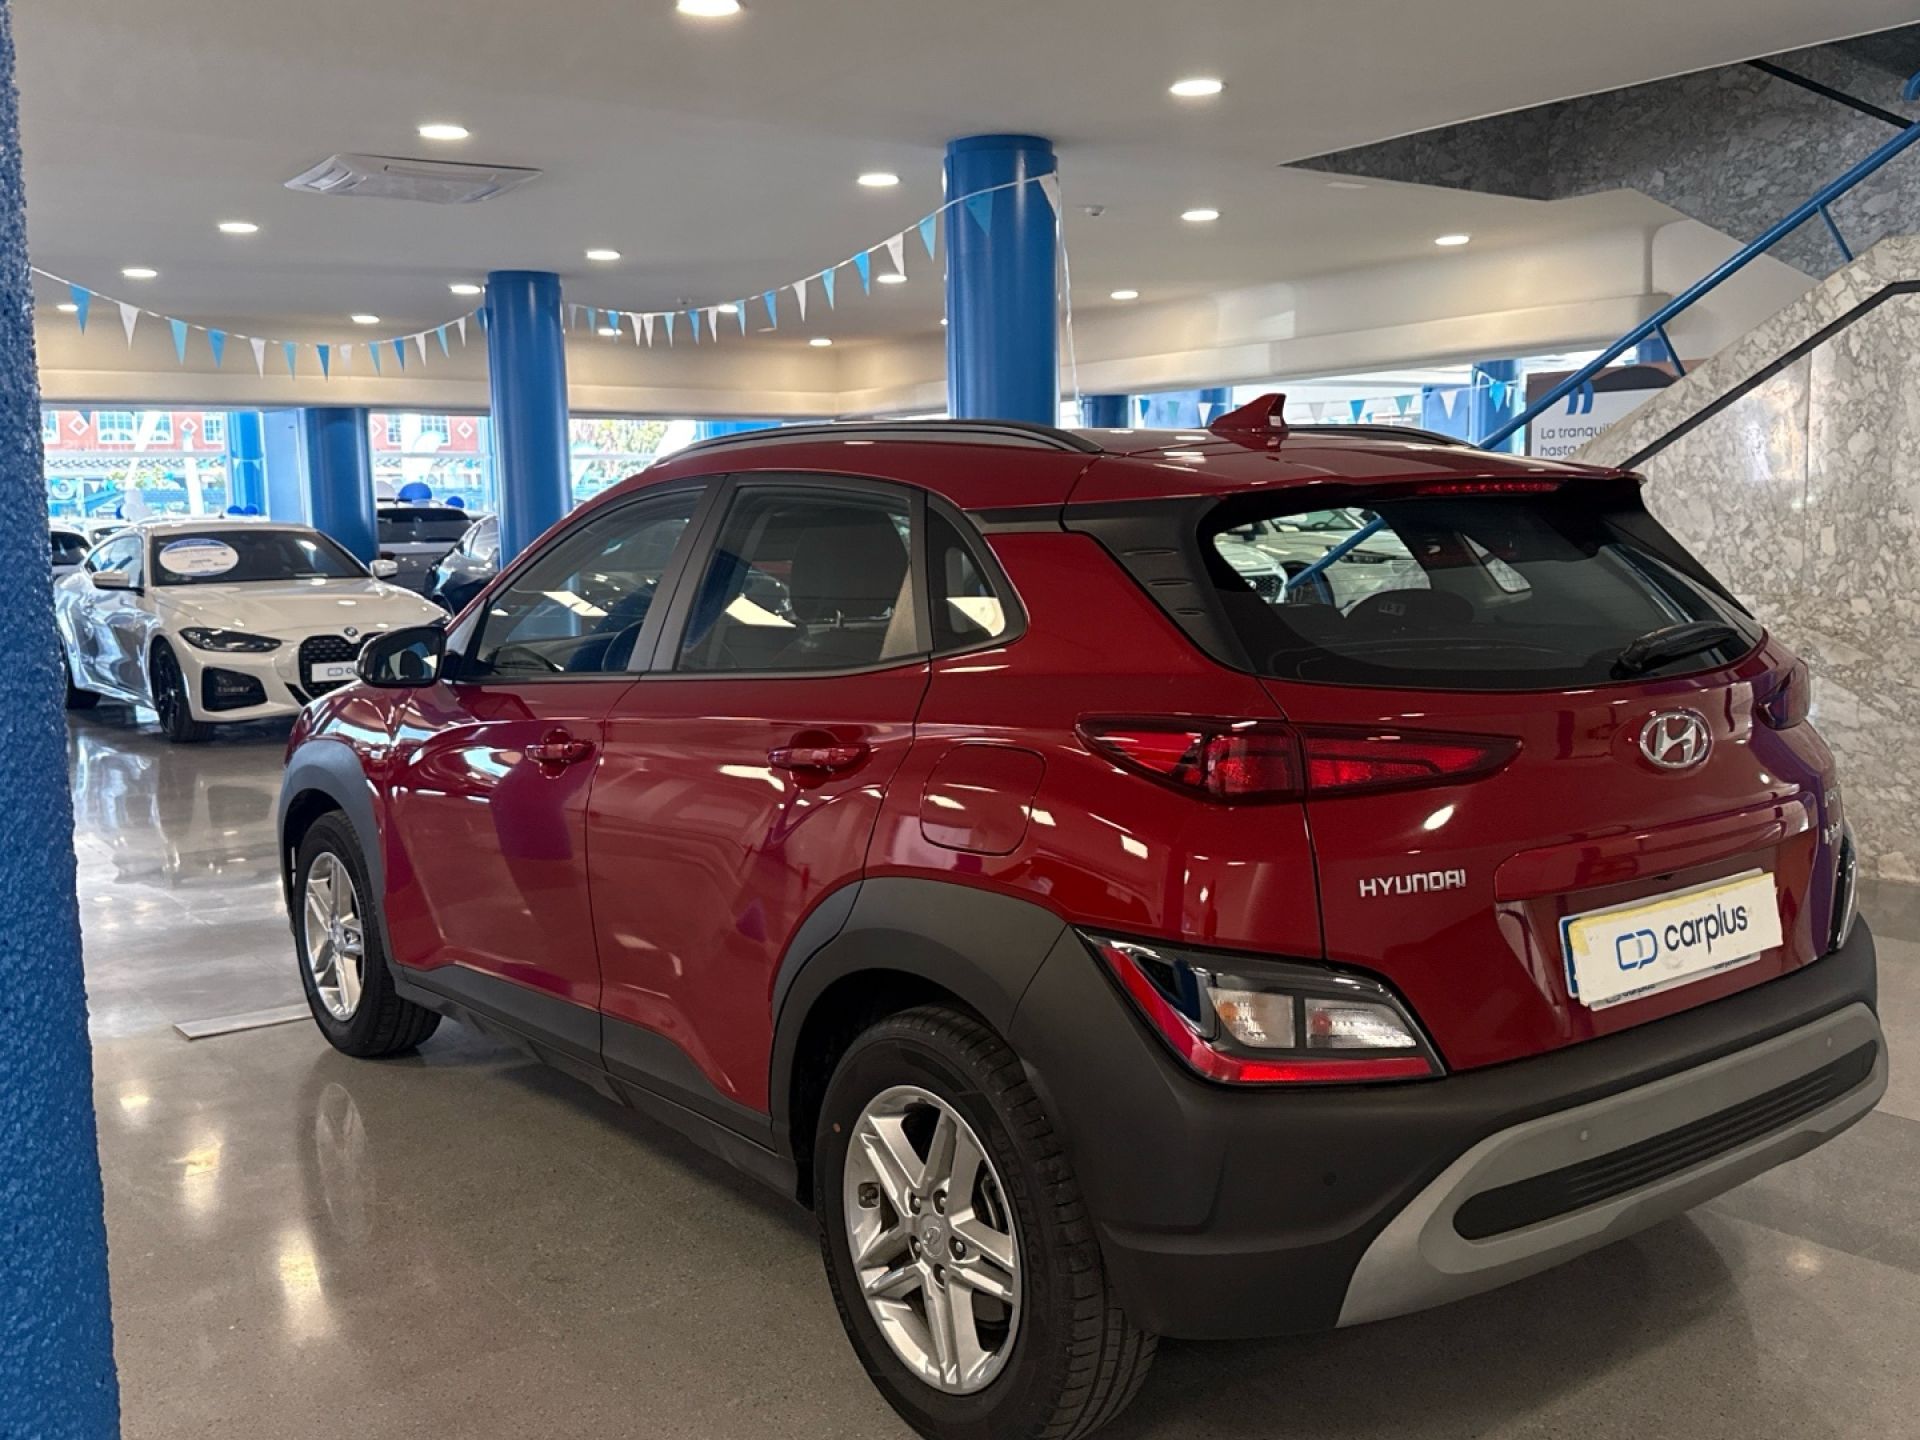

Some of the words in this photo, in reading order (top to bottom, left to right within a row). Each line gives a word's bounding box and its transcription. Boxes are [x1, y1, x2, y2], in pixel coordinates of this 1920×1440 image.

[1540, 427, 1555, 439] La
[1540, 445, 1577, 456] hasta
[1359, 868, 1466, 897] HYUNDAI
[1664, 903, 1748, 954] carplus
